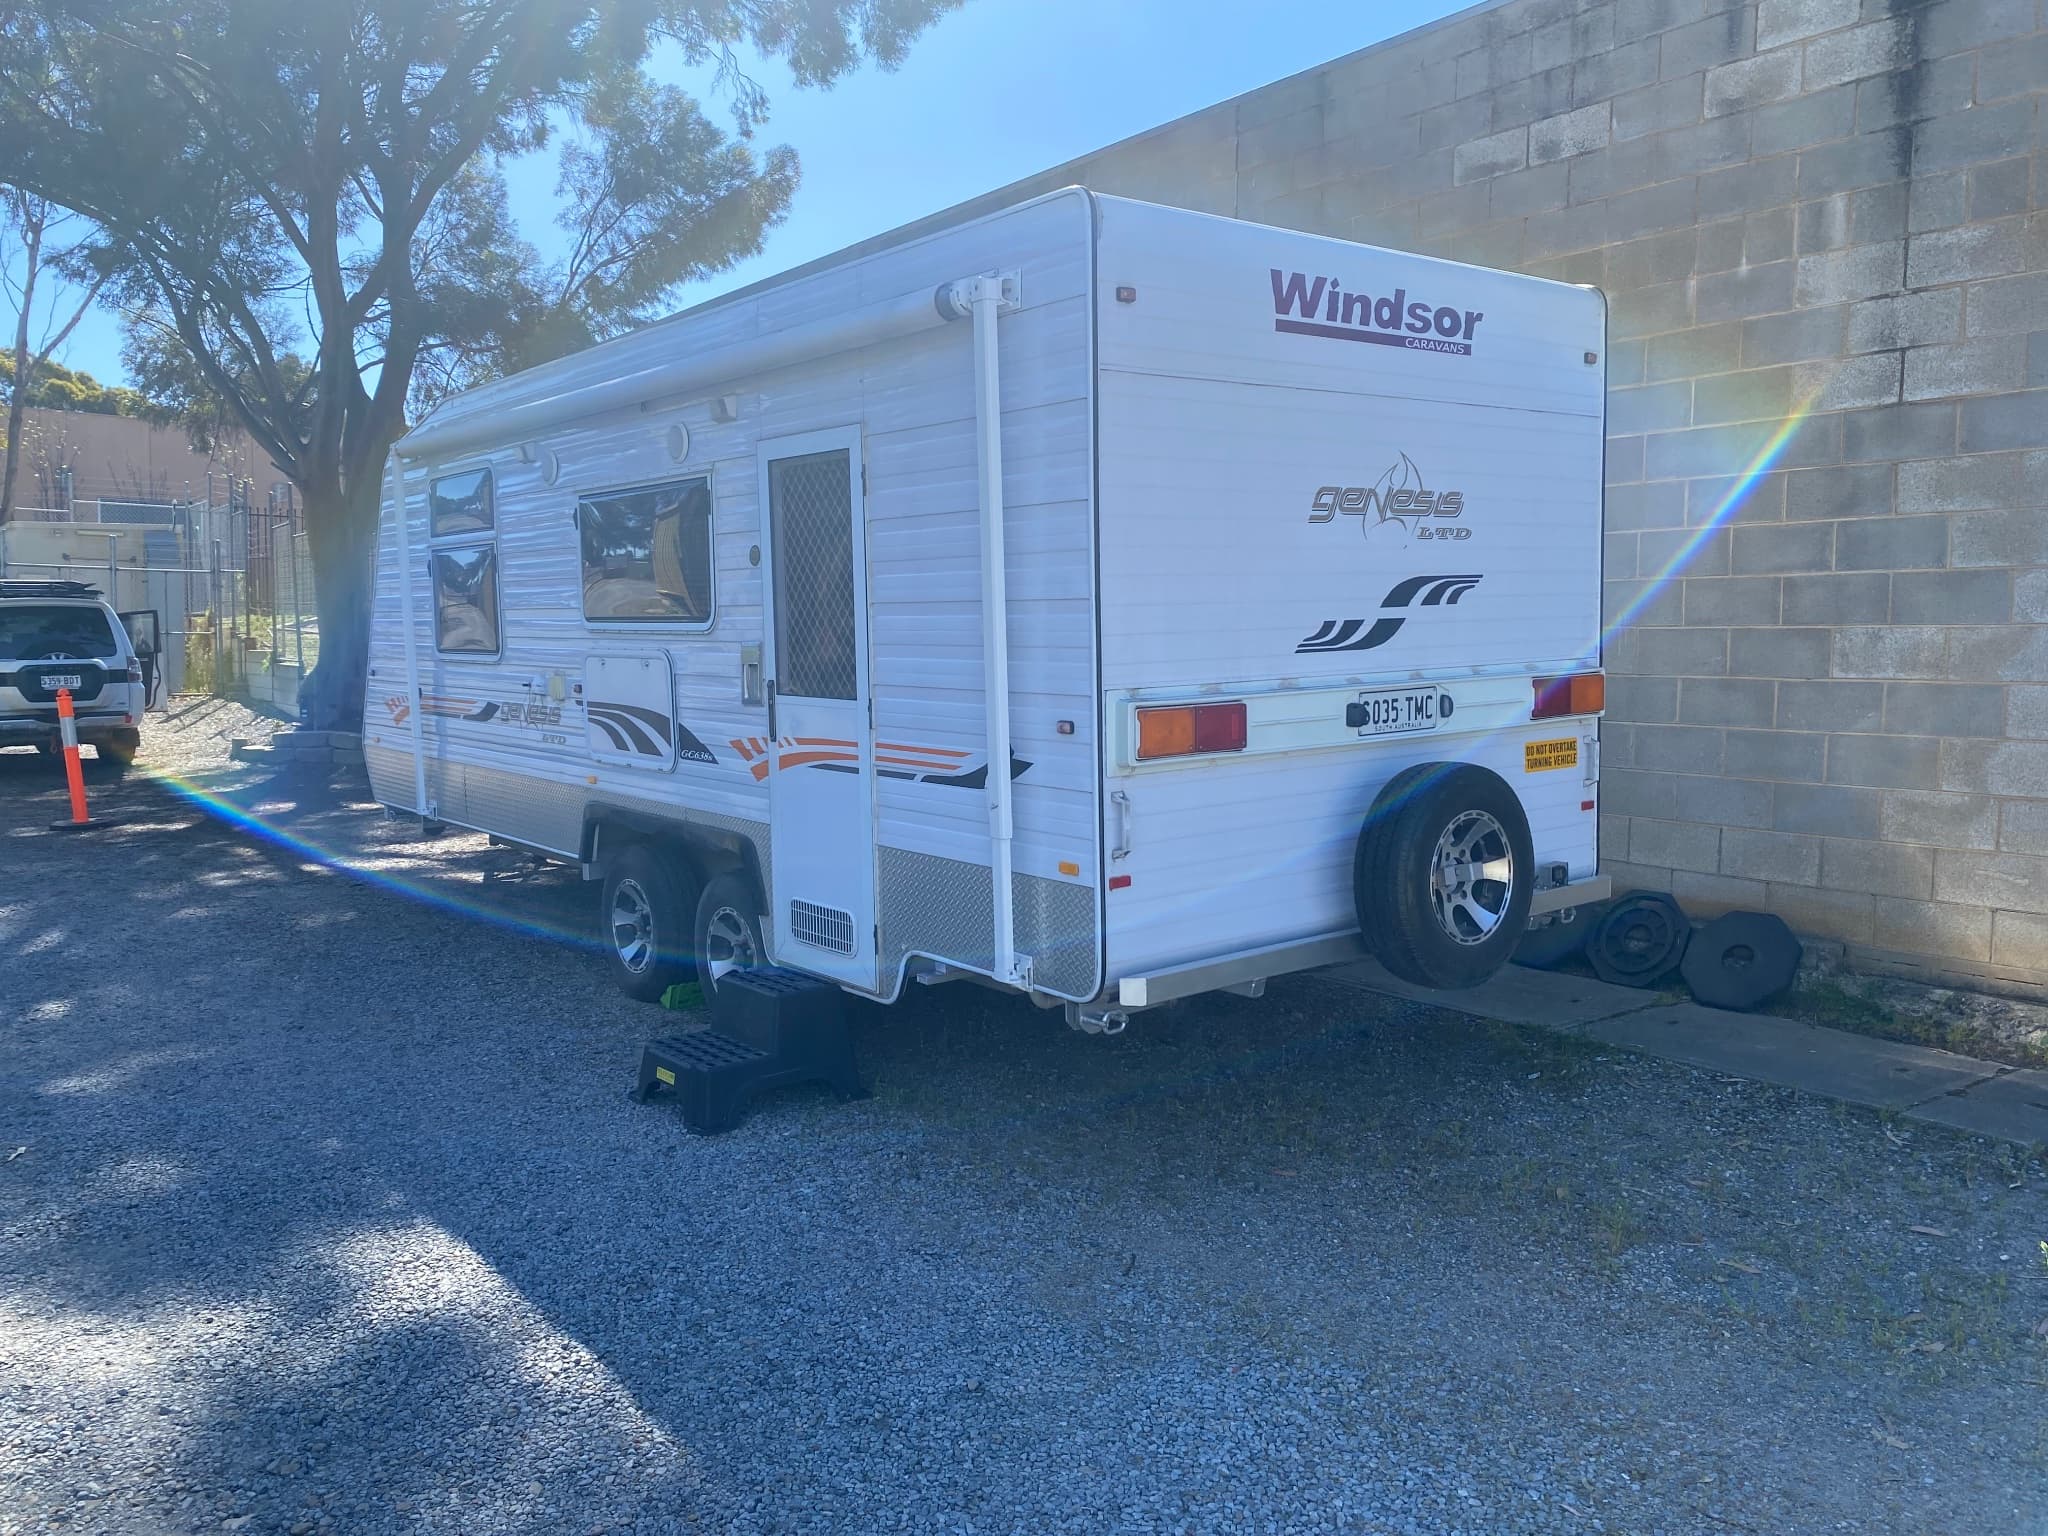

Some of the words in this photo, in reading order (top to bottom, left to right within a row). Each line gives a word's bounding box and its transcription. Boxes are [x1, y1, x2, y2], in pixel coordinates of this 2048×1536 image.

[1270, 268, 1484, 341] Windsor
[1405, 337, 1465, 354] CARAVANS
[1417, 526, 1472, 540] LTD
[1526, 746, 1535, 757] DO
[1536, 744, 1548, 755] NOT
[1549, 741, 1577, 754] OVERTAKE
[1527, 756, 1553, 770] TURNING
[1553, 753, 1577, 766] VEHICLE
